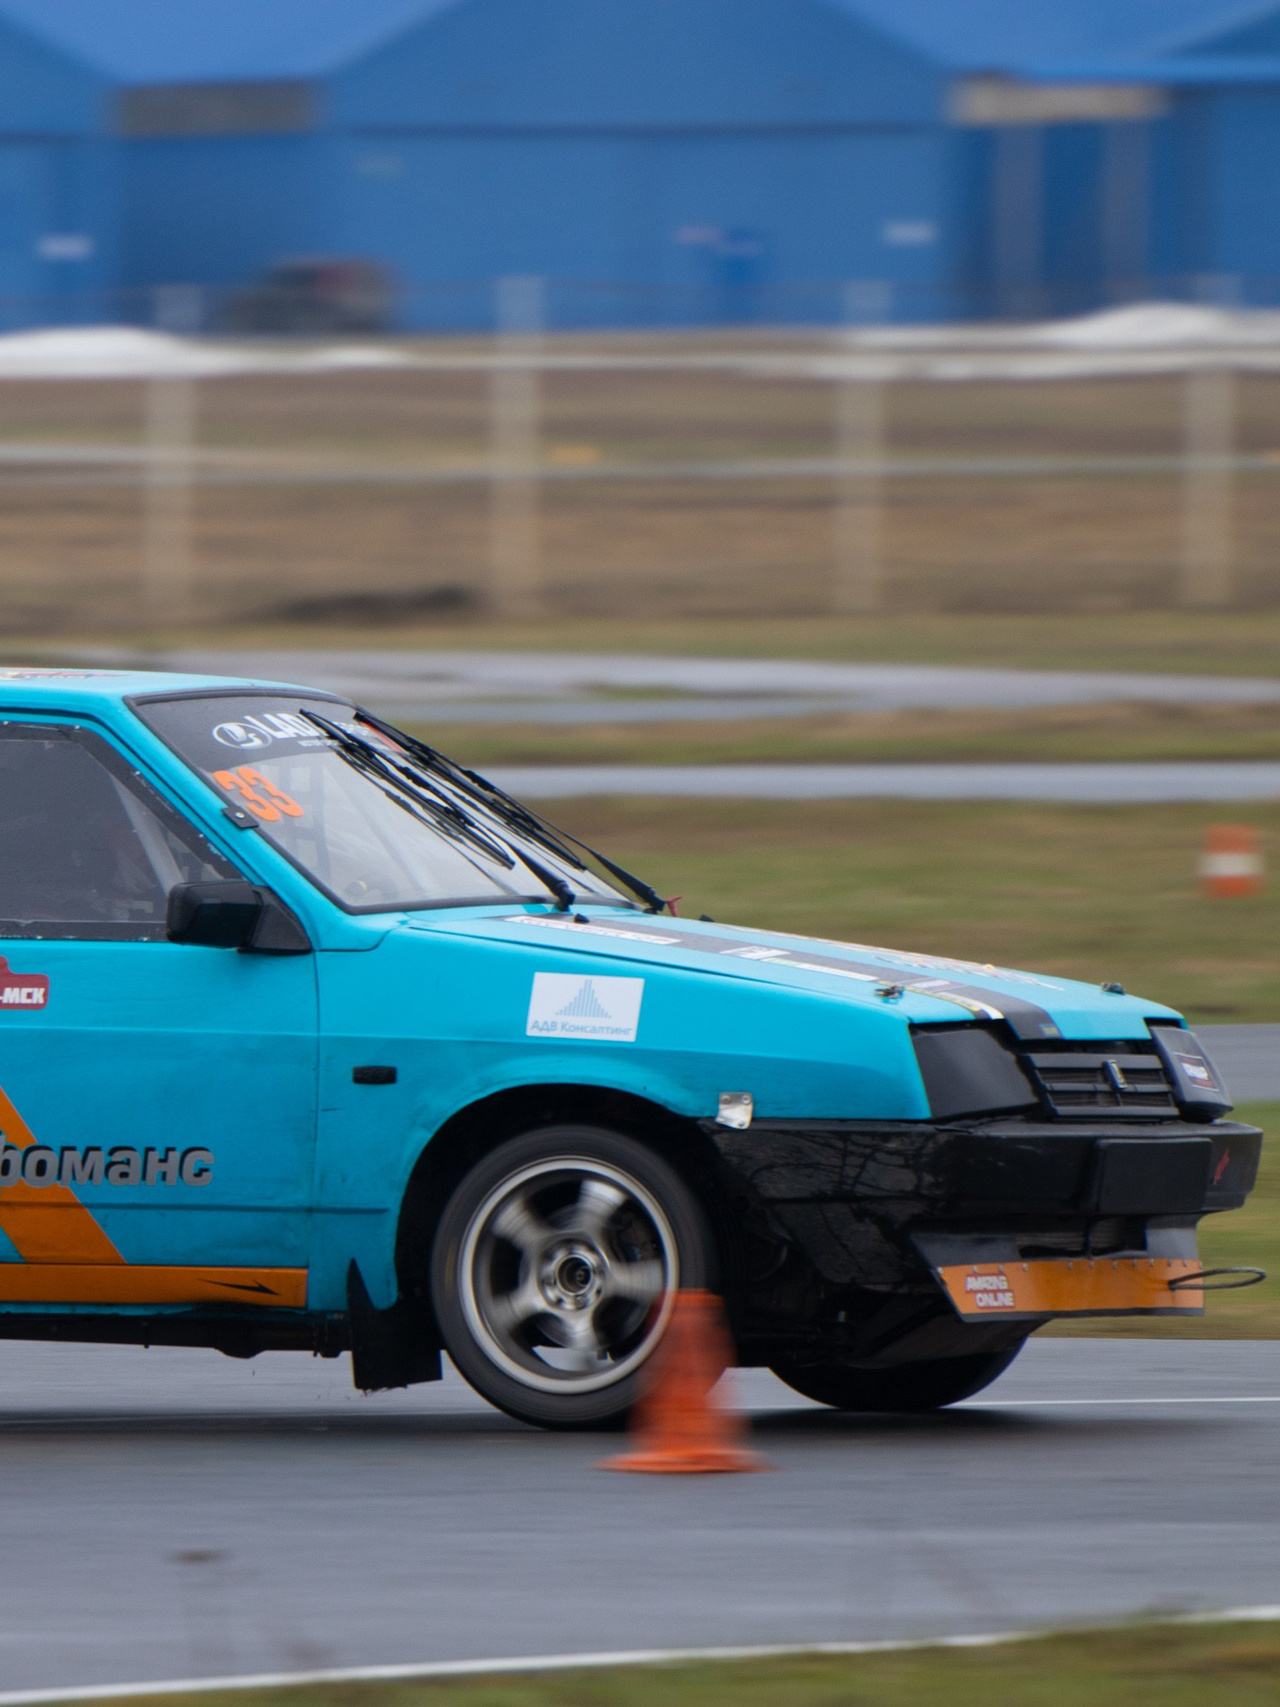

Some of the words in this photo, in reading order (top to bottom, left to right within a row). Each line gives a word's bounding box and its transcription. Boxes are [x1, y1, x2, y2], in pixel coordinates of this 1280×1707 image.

[213, 766, 304, 821] 33
[560, 1021, 634, 1037] Консалтинг
[975, 1292, 1014, 1307] ONLINE
